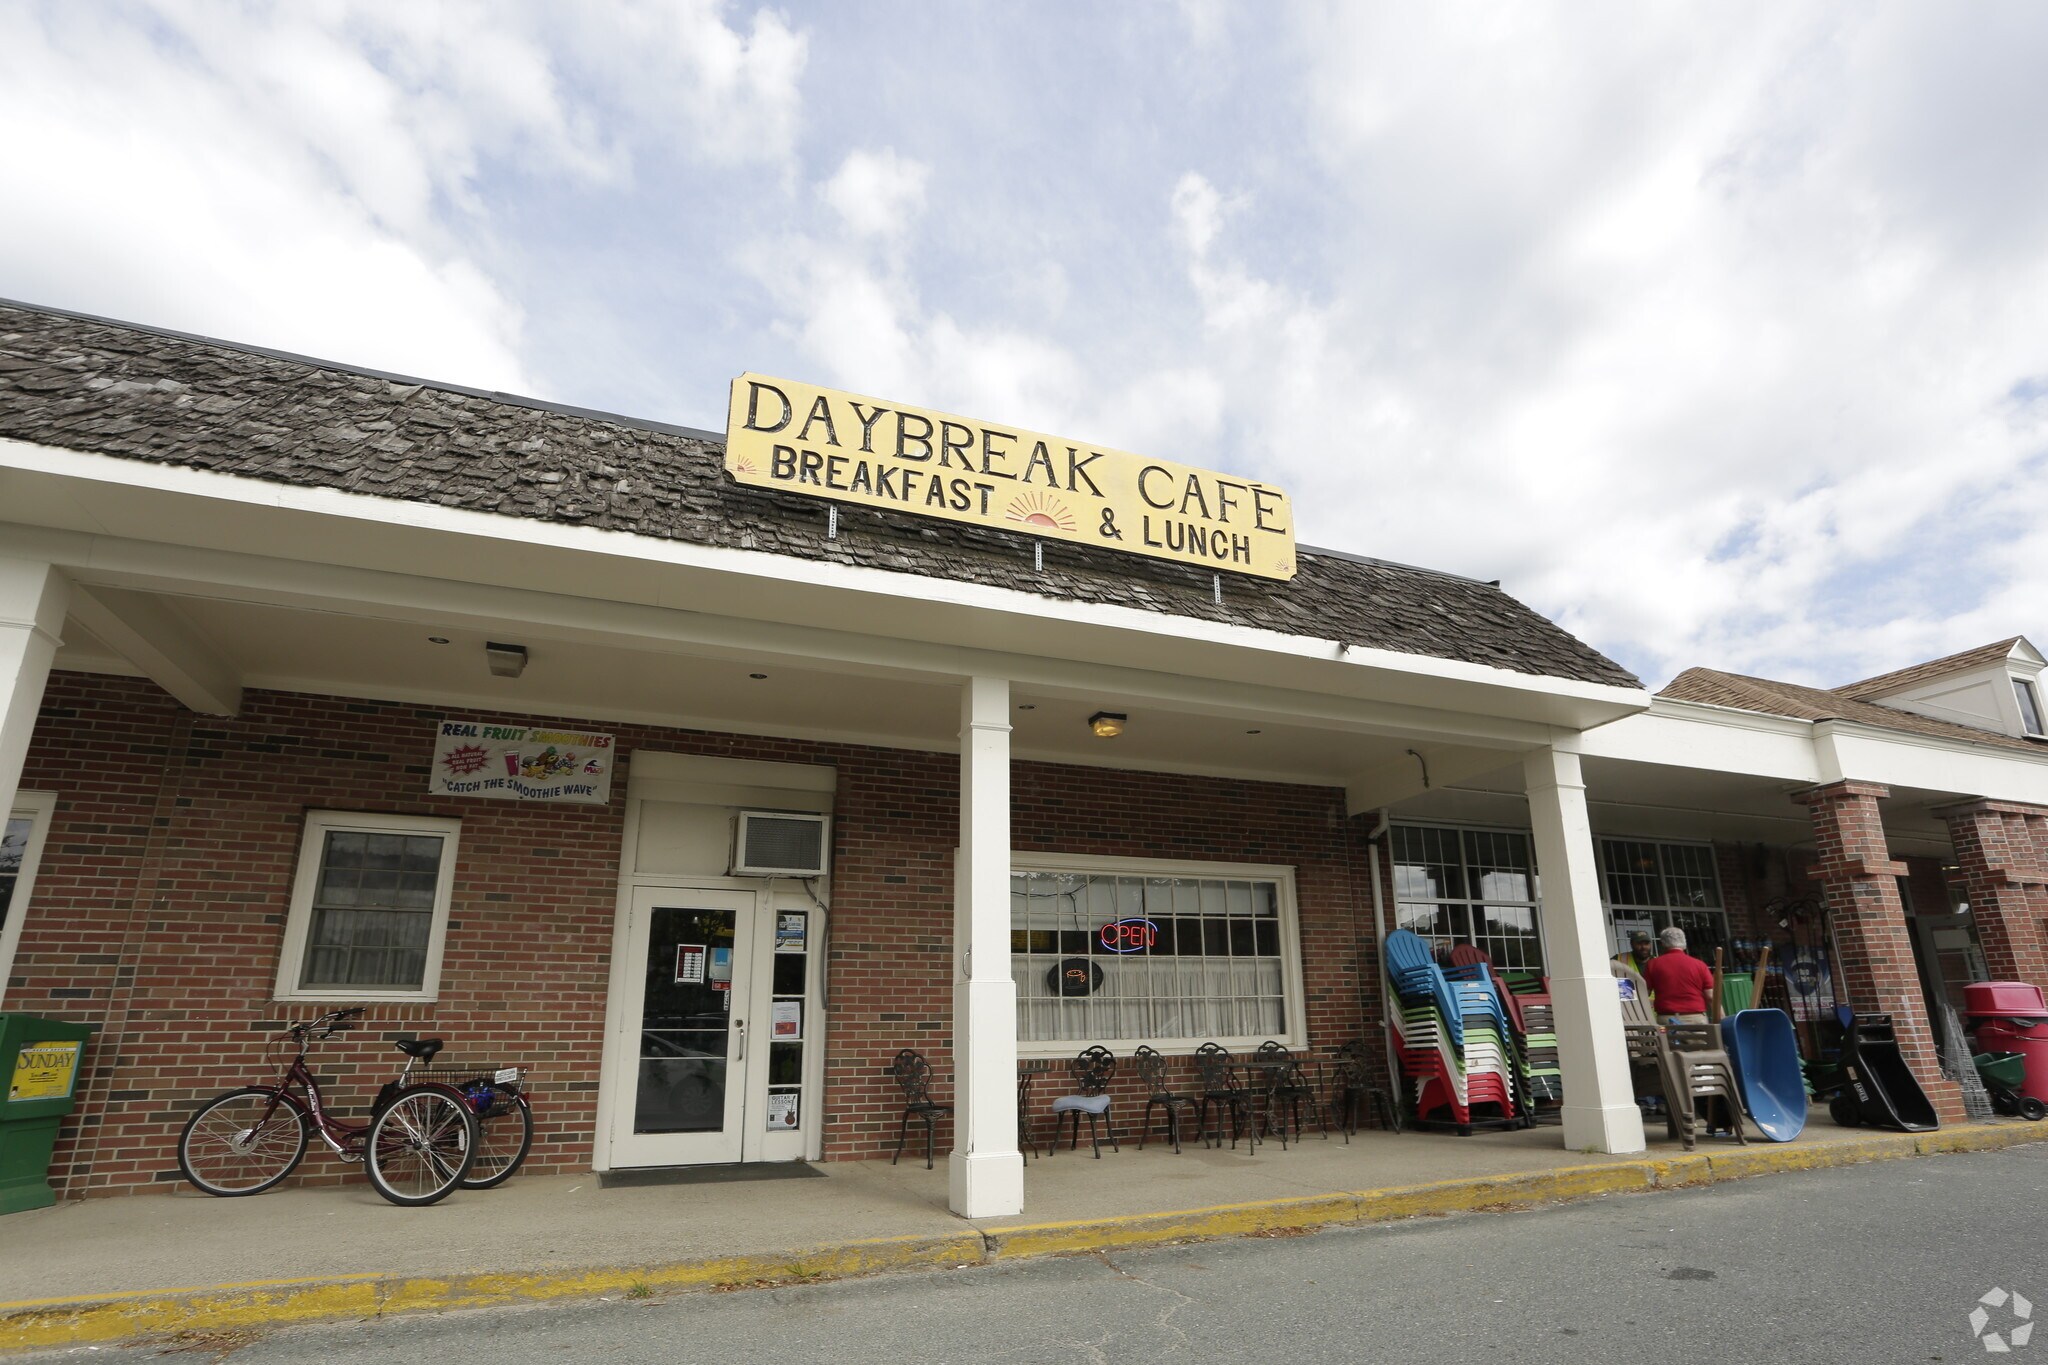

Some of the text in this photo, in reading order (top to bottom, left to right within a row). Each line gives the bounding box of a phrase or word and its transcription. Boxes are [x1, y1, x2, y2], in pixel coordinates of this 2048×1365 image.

[742, 381, 1286, 535] DAYBREAK CAFÉ
[770, 444, 995, 516] BREAKFAST
[1099, 507, 1251, 564] & LUNCH
[441, 723, 611, 748] REAL FRUIT SMOOTHIES
[483, 778, 504, 790] THE
[506, 779, 561, 799] SMOOTHIE
[1101, 924, 1155, 946] OPEN
[17, 1052, 75, 1069] SUNDAY
